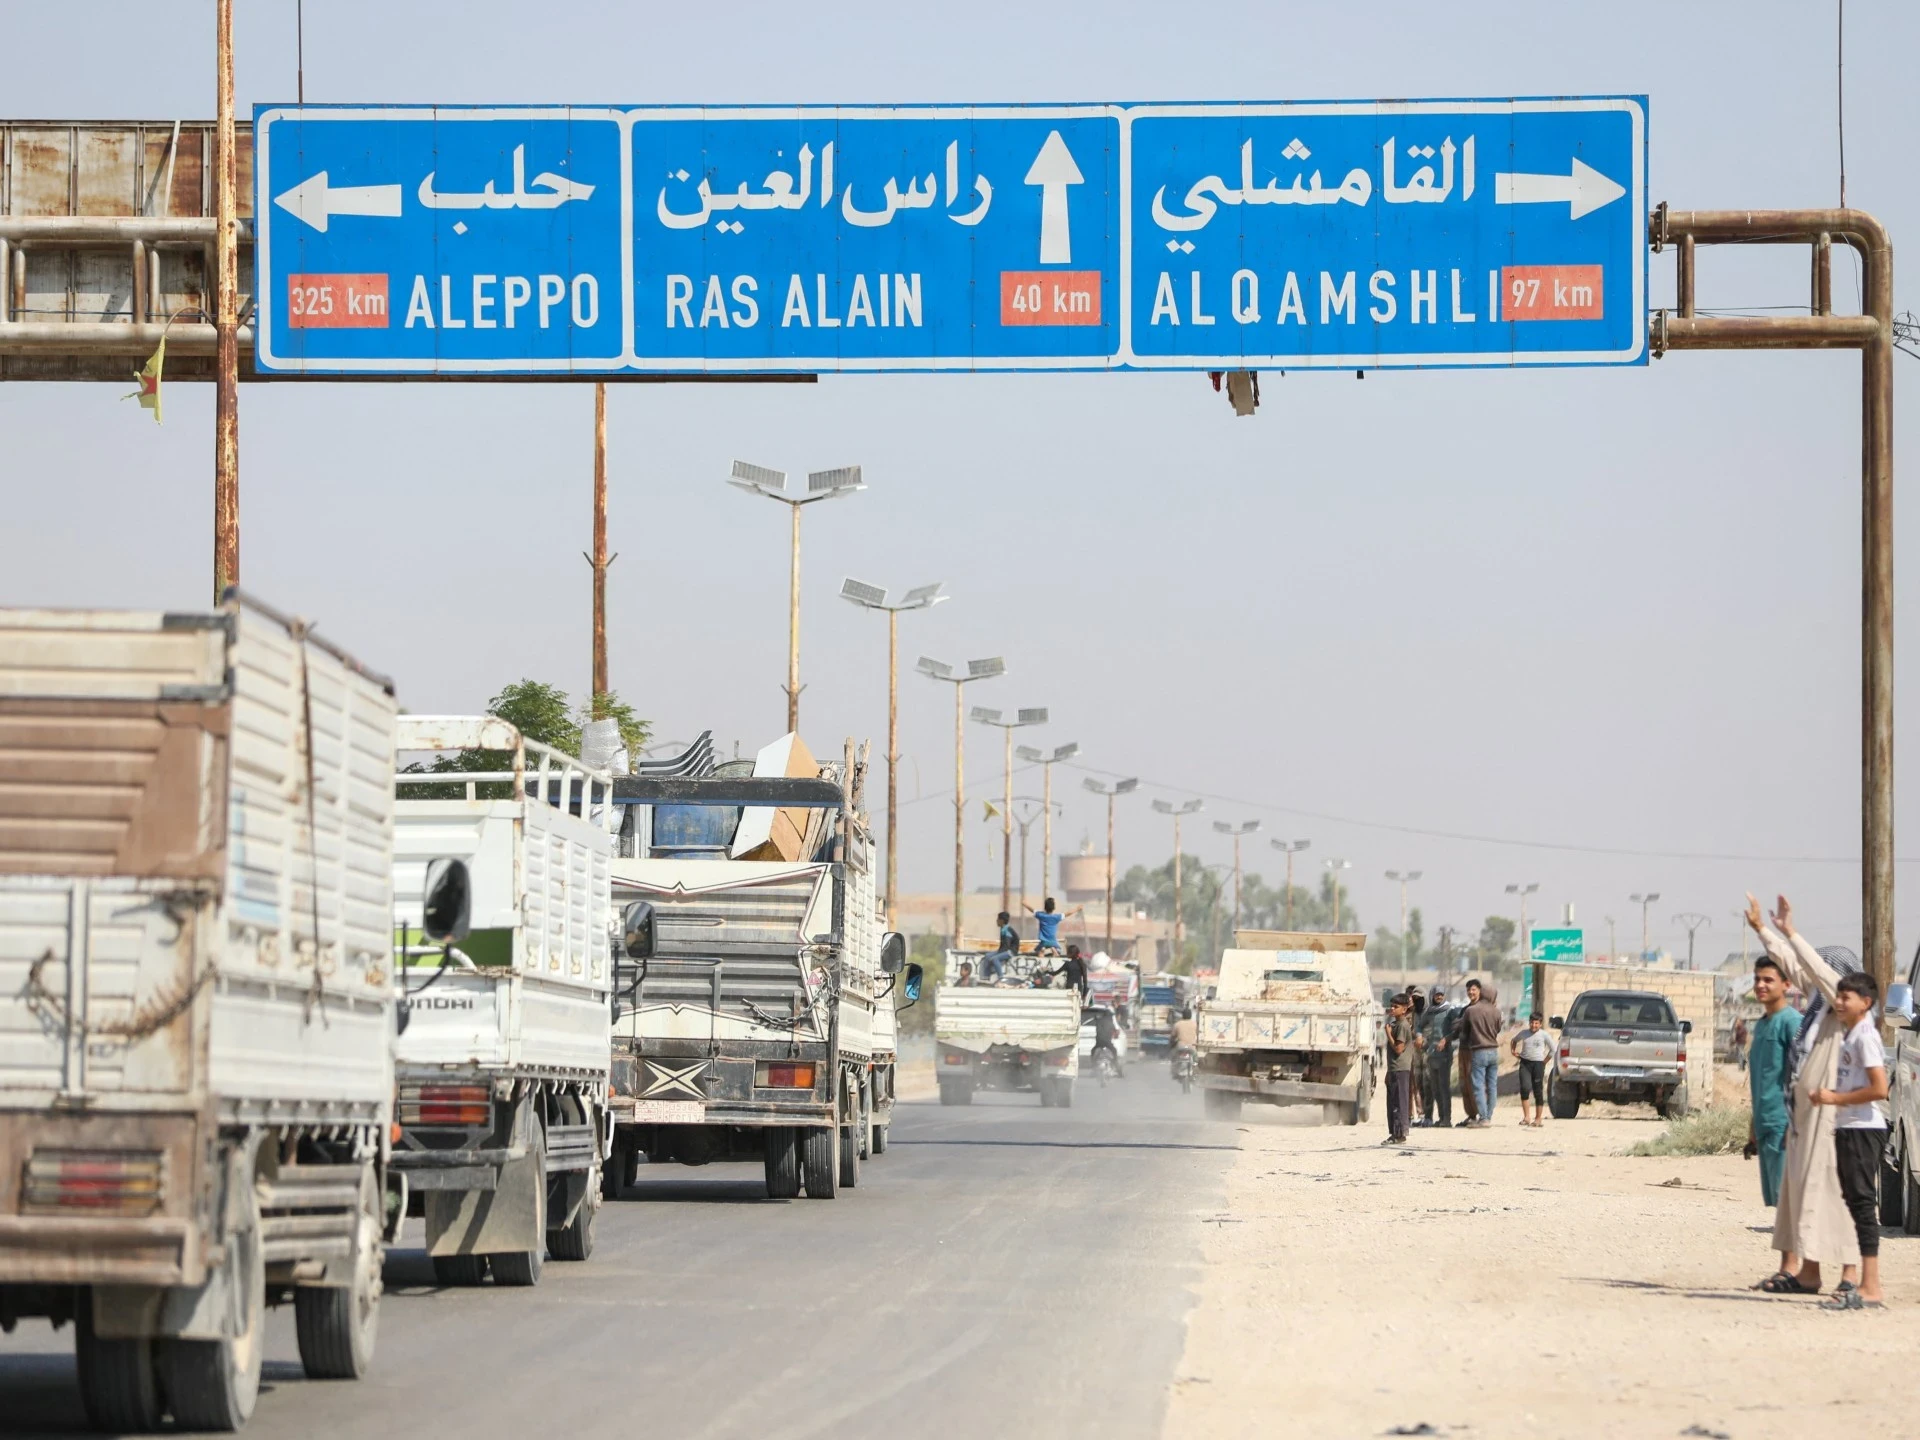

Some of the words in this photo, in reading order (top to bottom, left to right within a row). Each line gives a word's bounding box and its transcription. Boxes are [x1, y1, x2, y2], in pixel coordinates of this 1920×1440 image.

[419, 143, 596, 235] حلب
[657, 141, 833, 235] العين
[842, 140, 992, 227] راس
[1152, 135, 1475, 255] القامشلي
[292, 286, 333, 315] 325
[348, 287, 385, 315] km
[405, 273, 599, 329] ALEPPO
[666, 274, 759, 329] RAS
[781, 273, 923, 328] ALAIN
[1012, 284, 1042, 313] 40
[1053, 284, 1091, 313] km
[1512, 279, 1541, 308] 97
[1554, 279, 1593, 307] km
